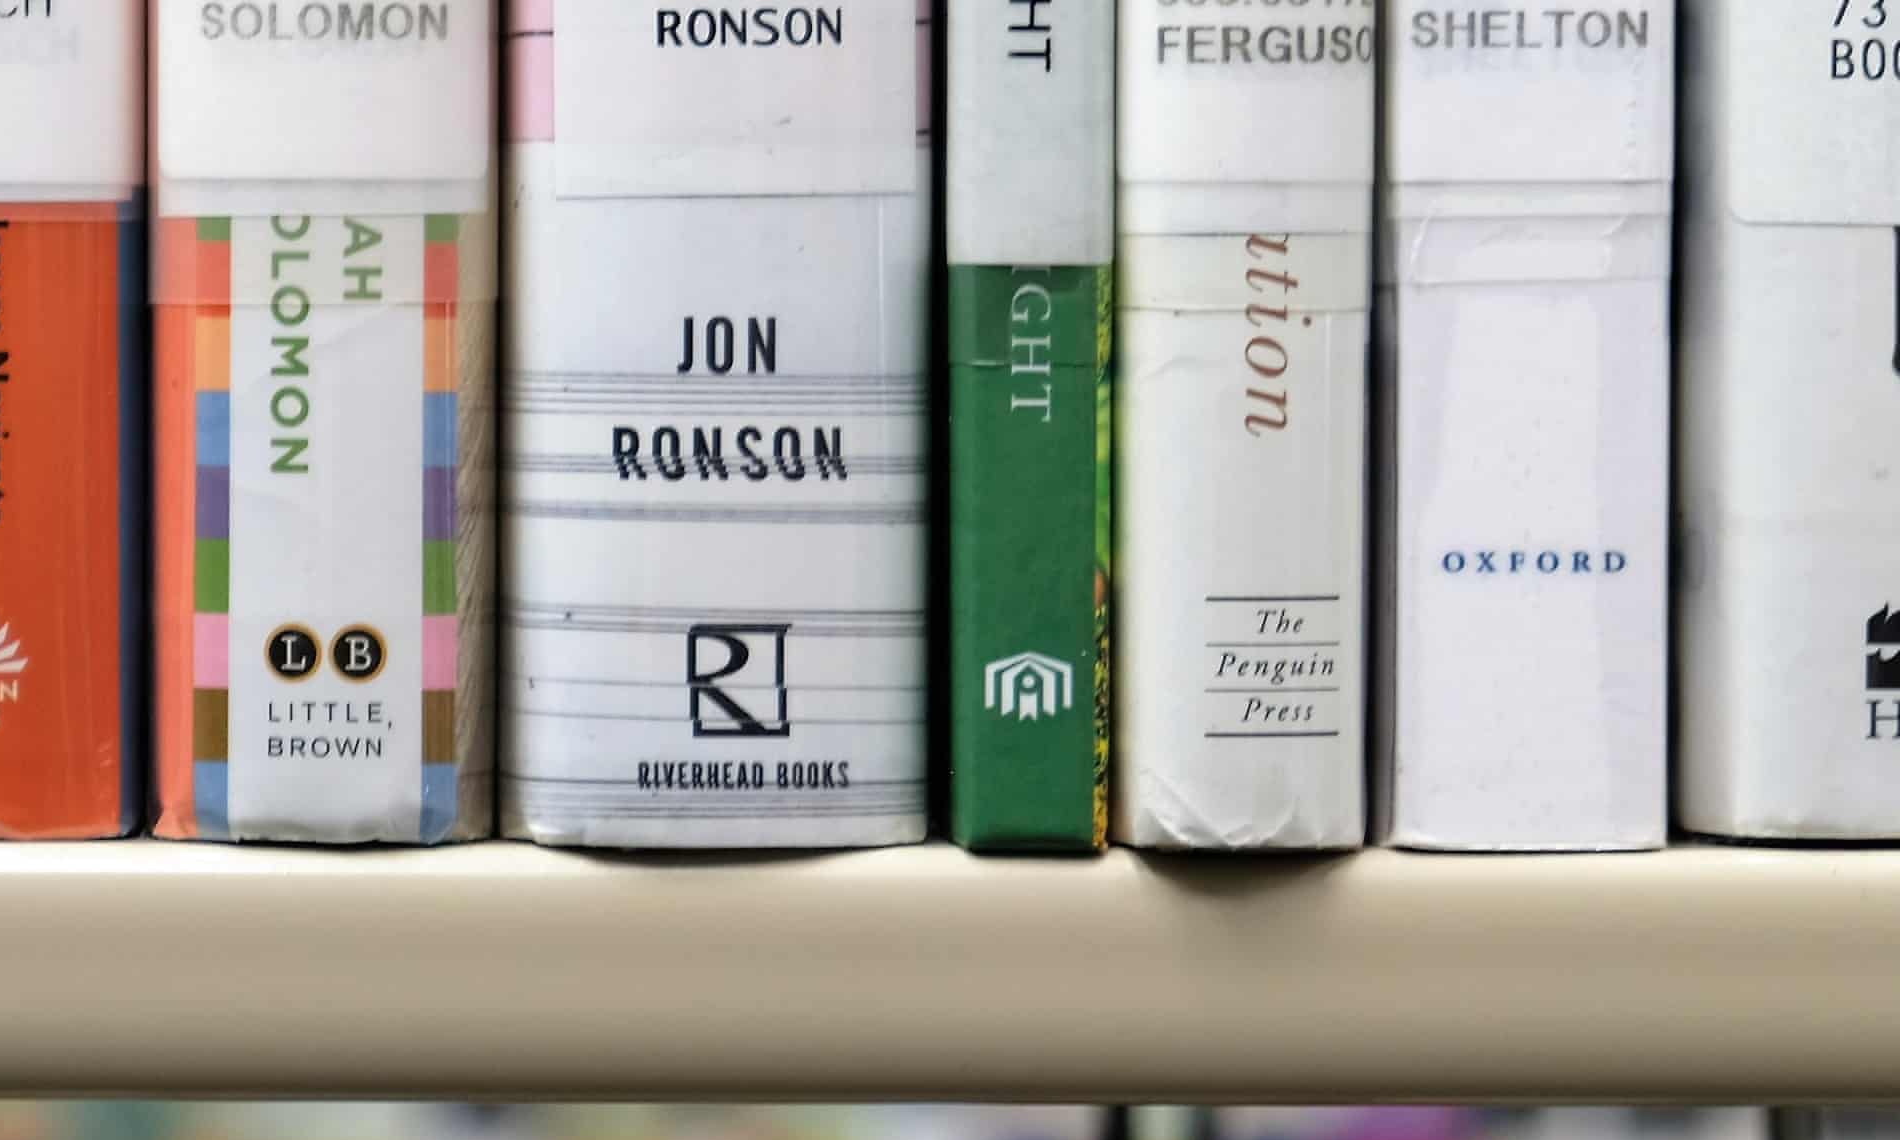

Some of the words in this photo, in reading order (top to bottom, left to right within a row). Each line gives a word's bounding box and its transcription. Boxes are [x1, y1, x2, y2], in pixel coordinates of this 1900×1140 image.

[201, 2, 448, 41] SOLOMON
[658, 8, 841, 46] RONSON
[1413, 11, 1648, 48] SHELTON
[678, 317, 775, 375] JON
[611, 427, 848, 481] RONSON
[1443, 552, 1625, 572] OXFORD
[1258, 609, 1303, 633] The
[1216, 652, 1334, 683] Penguin
[269, 703, 391, 728] LITTLE,
[1244, 698, 1312, 721] Press
[268, 738, 381, 756] BROWN
[638, 763, 764, 789] RIVERHEAD
[777, 762, 850, 788] BOOKS
